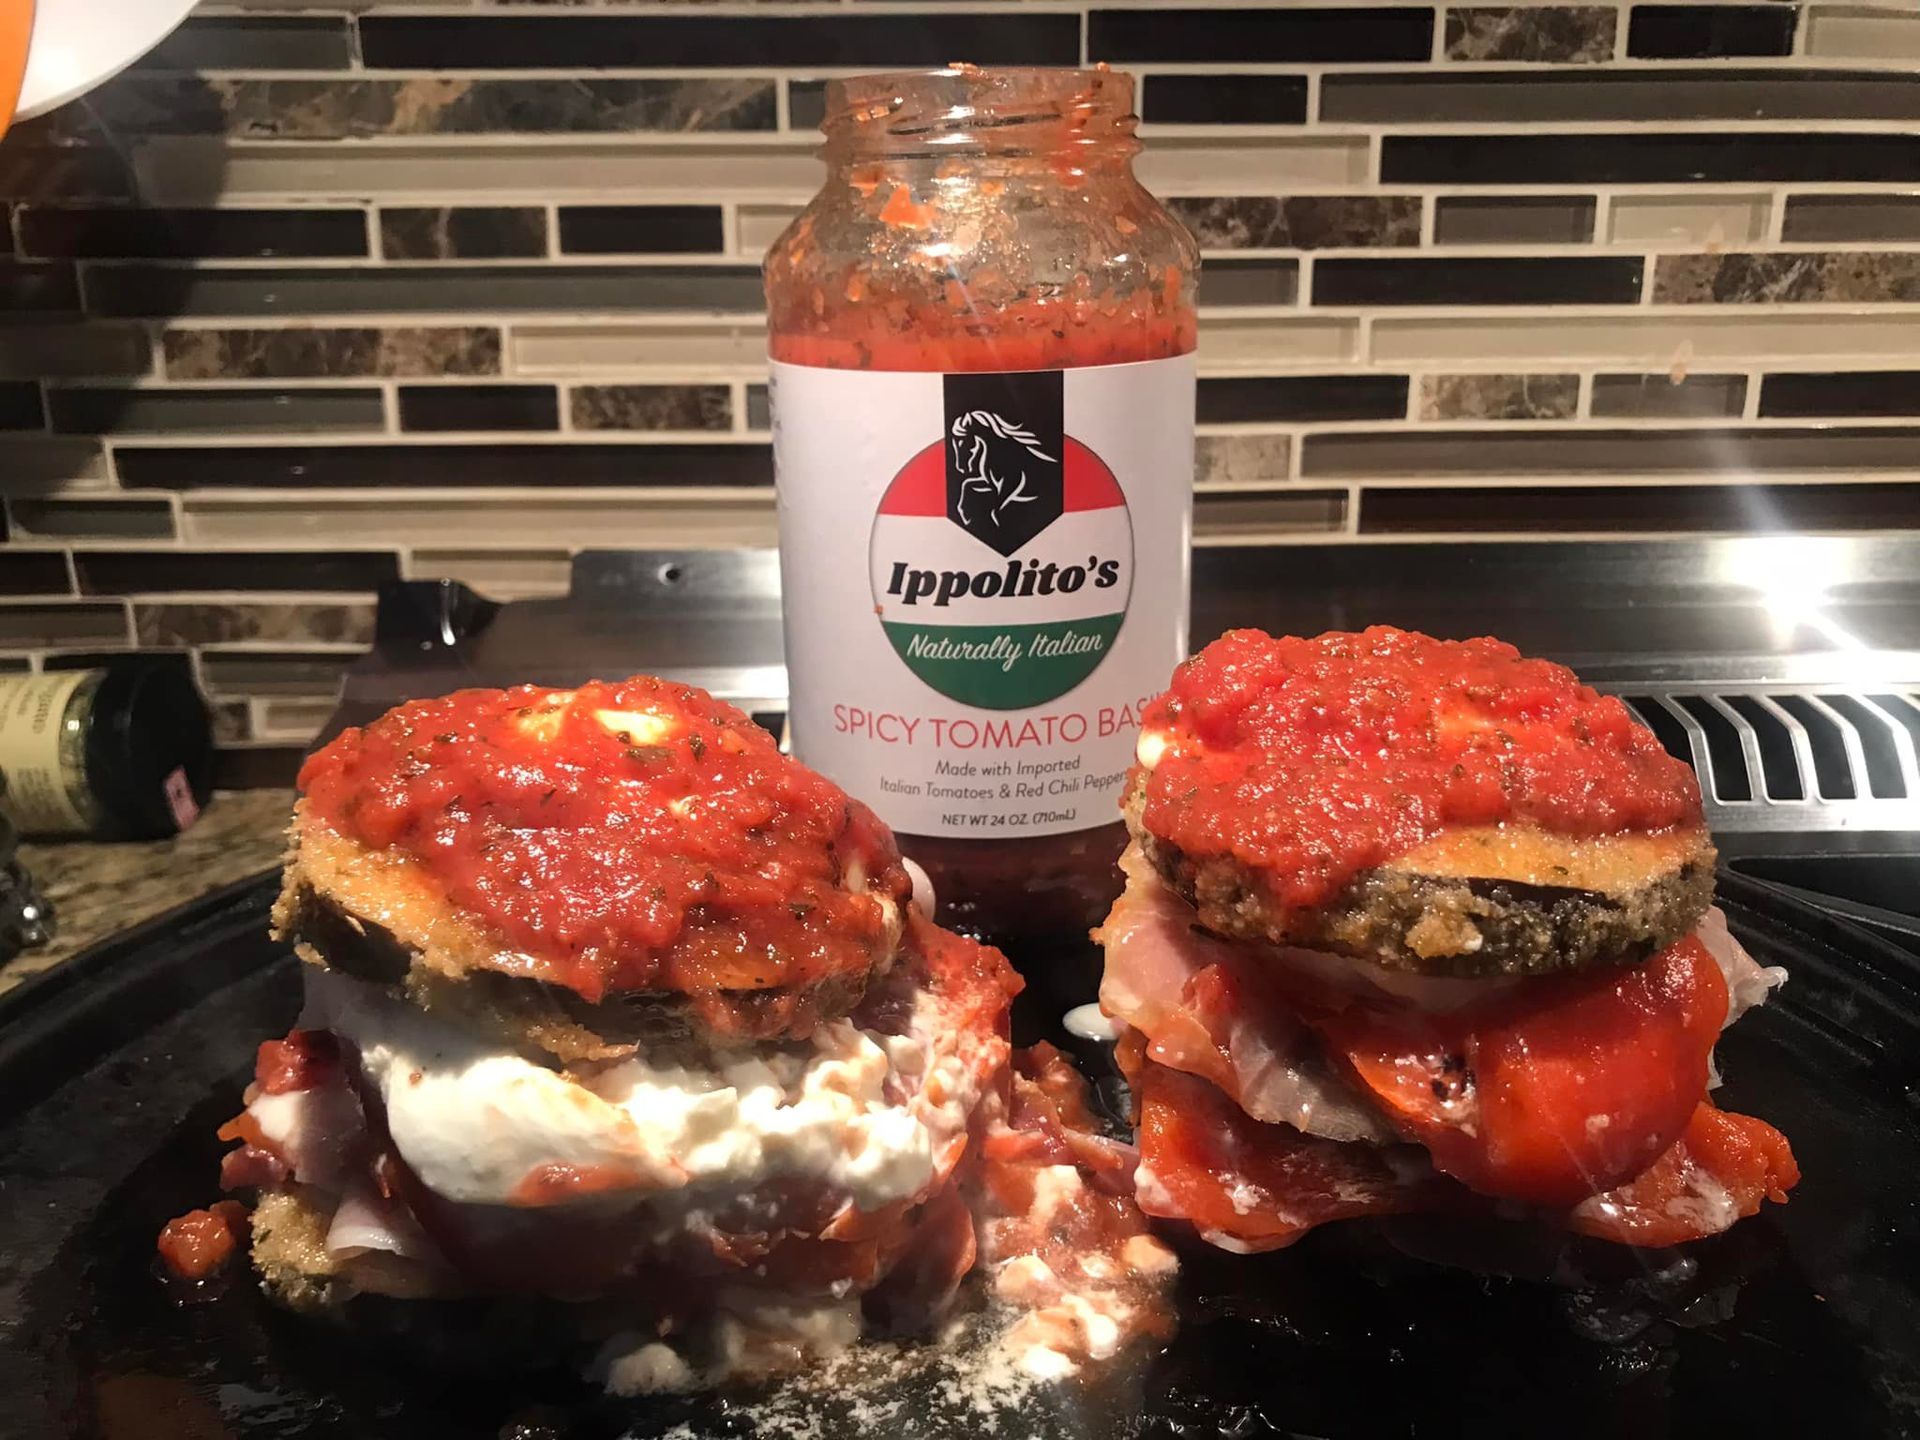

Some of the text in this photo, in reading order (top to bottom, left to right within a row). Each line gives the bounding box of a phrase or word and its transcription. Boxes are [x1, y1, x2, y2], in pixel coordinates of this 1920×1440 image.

[887, 556, 1119, 606] Ippolito's
[907, 630, 1102, 671] Naturally Italian
[834, 692, 1159, 748] SPICY TOMATO BAS
[935, 755, 1080, 779] Made with Imported
[880, 776, 920, 795] Italian
[926, 781, 993, 799] Tomatoes
[999, 783, 1010, 798] &
[1015, 782, 1044, 798] Red
[1048, 779, 1080, 795] Chili
[942, 813, 966, 826] NET
[969, 814, 988, 826] WT
[990, 814, 1005, 826] 24
[1033, 808, 1076, 825] (710mL)
